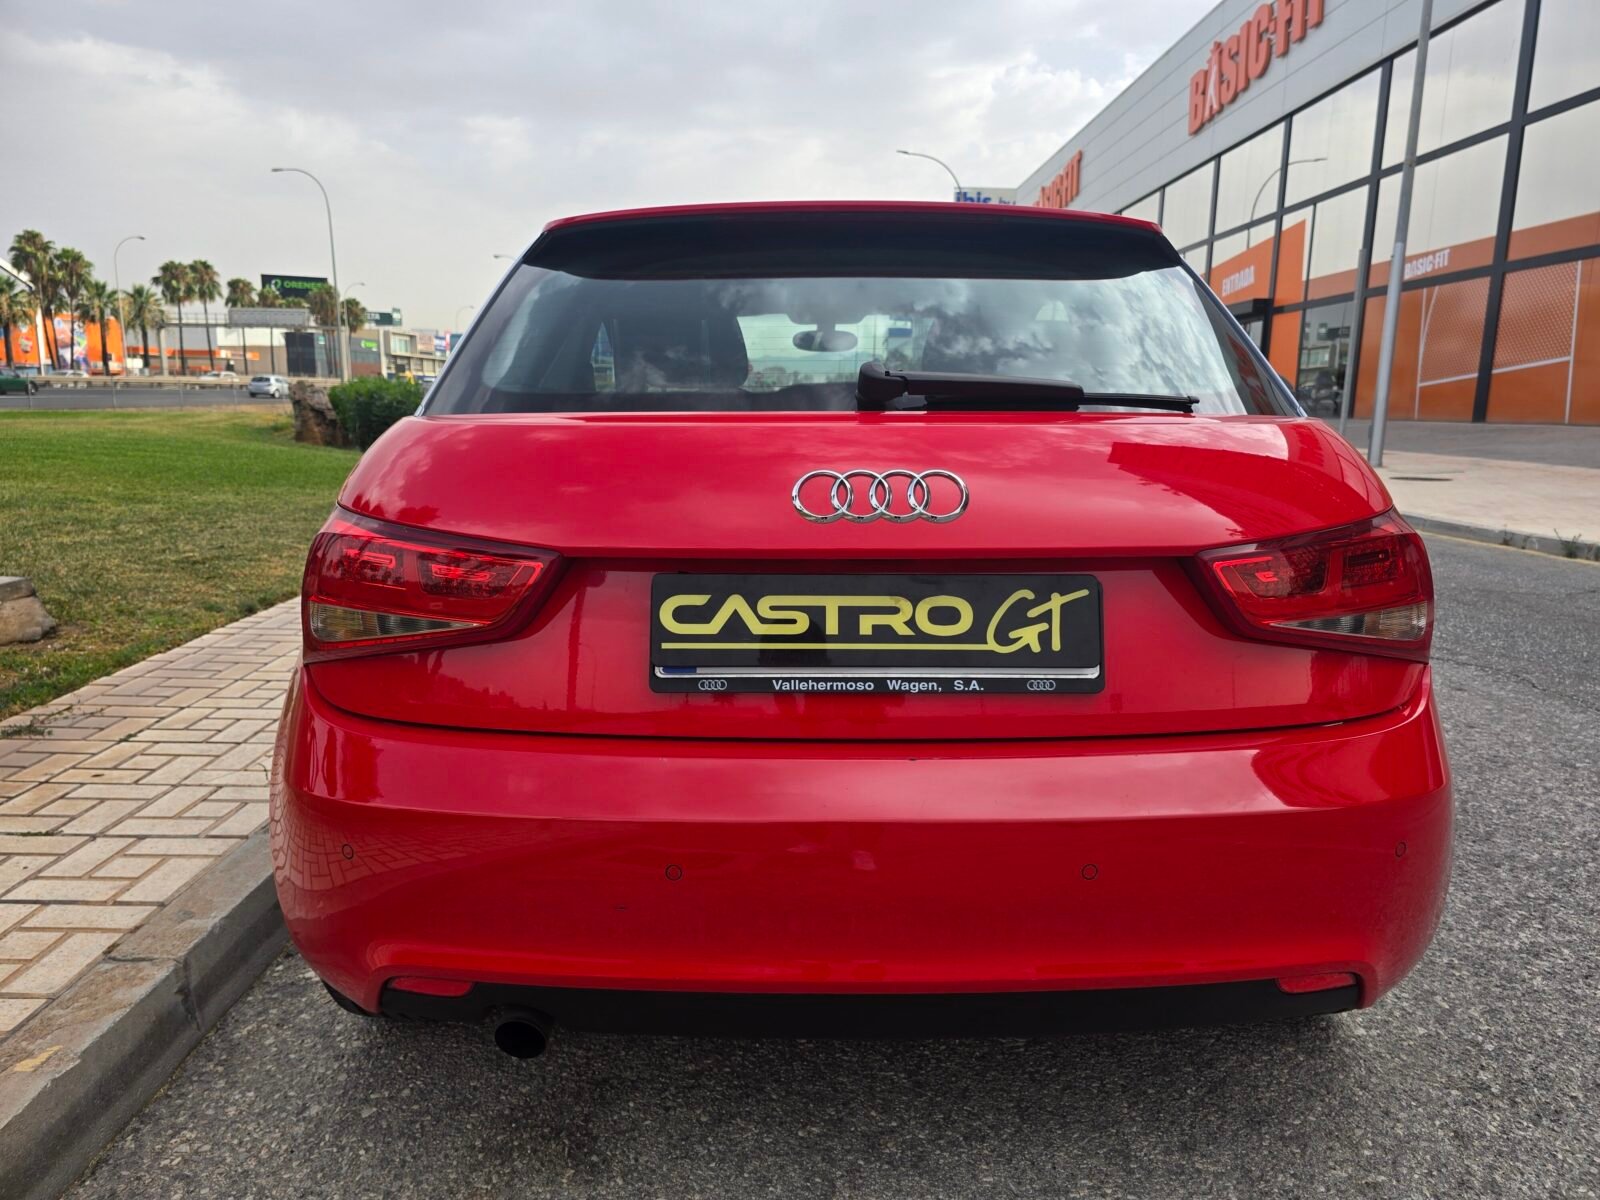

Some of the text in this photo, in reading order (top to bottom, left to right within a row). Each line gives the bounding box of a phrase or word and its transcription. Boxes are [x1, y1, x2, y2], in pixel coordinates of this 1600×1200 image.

[1222, 265, 1255, 297] ENTRADA
[659, 588, 1090, 653] CASTRO GT
[772, 679, 985, 693] Vallehermoso Wagen, S.A.
